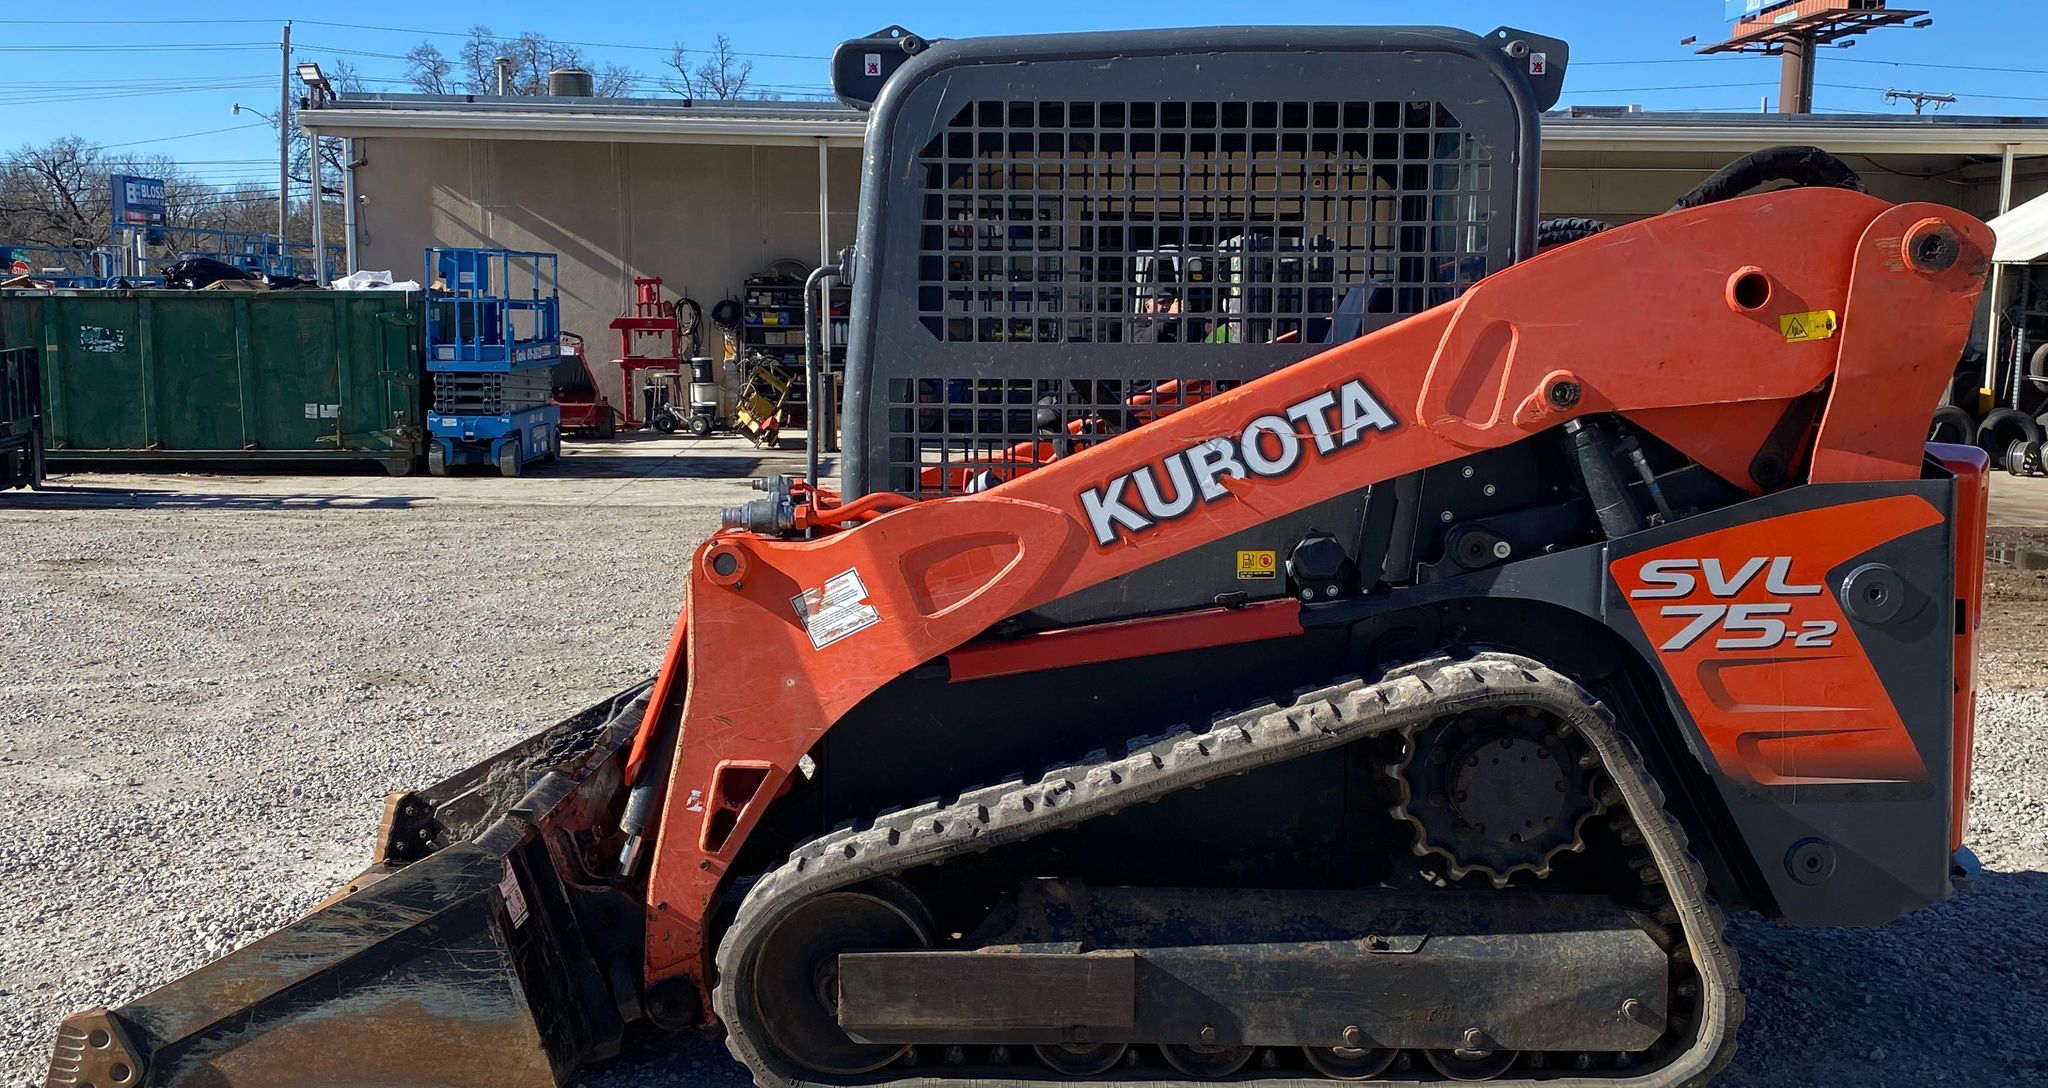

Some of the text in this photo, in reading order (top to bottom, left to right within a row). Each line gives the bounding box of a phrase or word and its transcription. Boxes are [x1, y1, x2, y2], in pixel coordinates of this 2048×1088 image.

[141, 184, 165, 200] BLOSS
[12, 266, 29, 276] STOP
[1080, 379, 1398, 546] KUBOTA
[1629, 556, 1823, 599] SVL
[1658, 602, 1839, 651] 75-2
